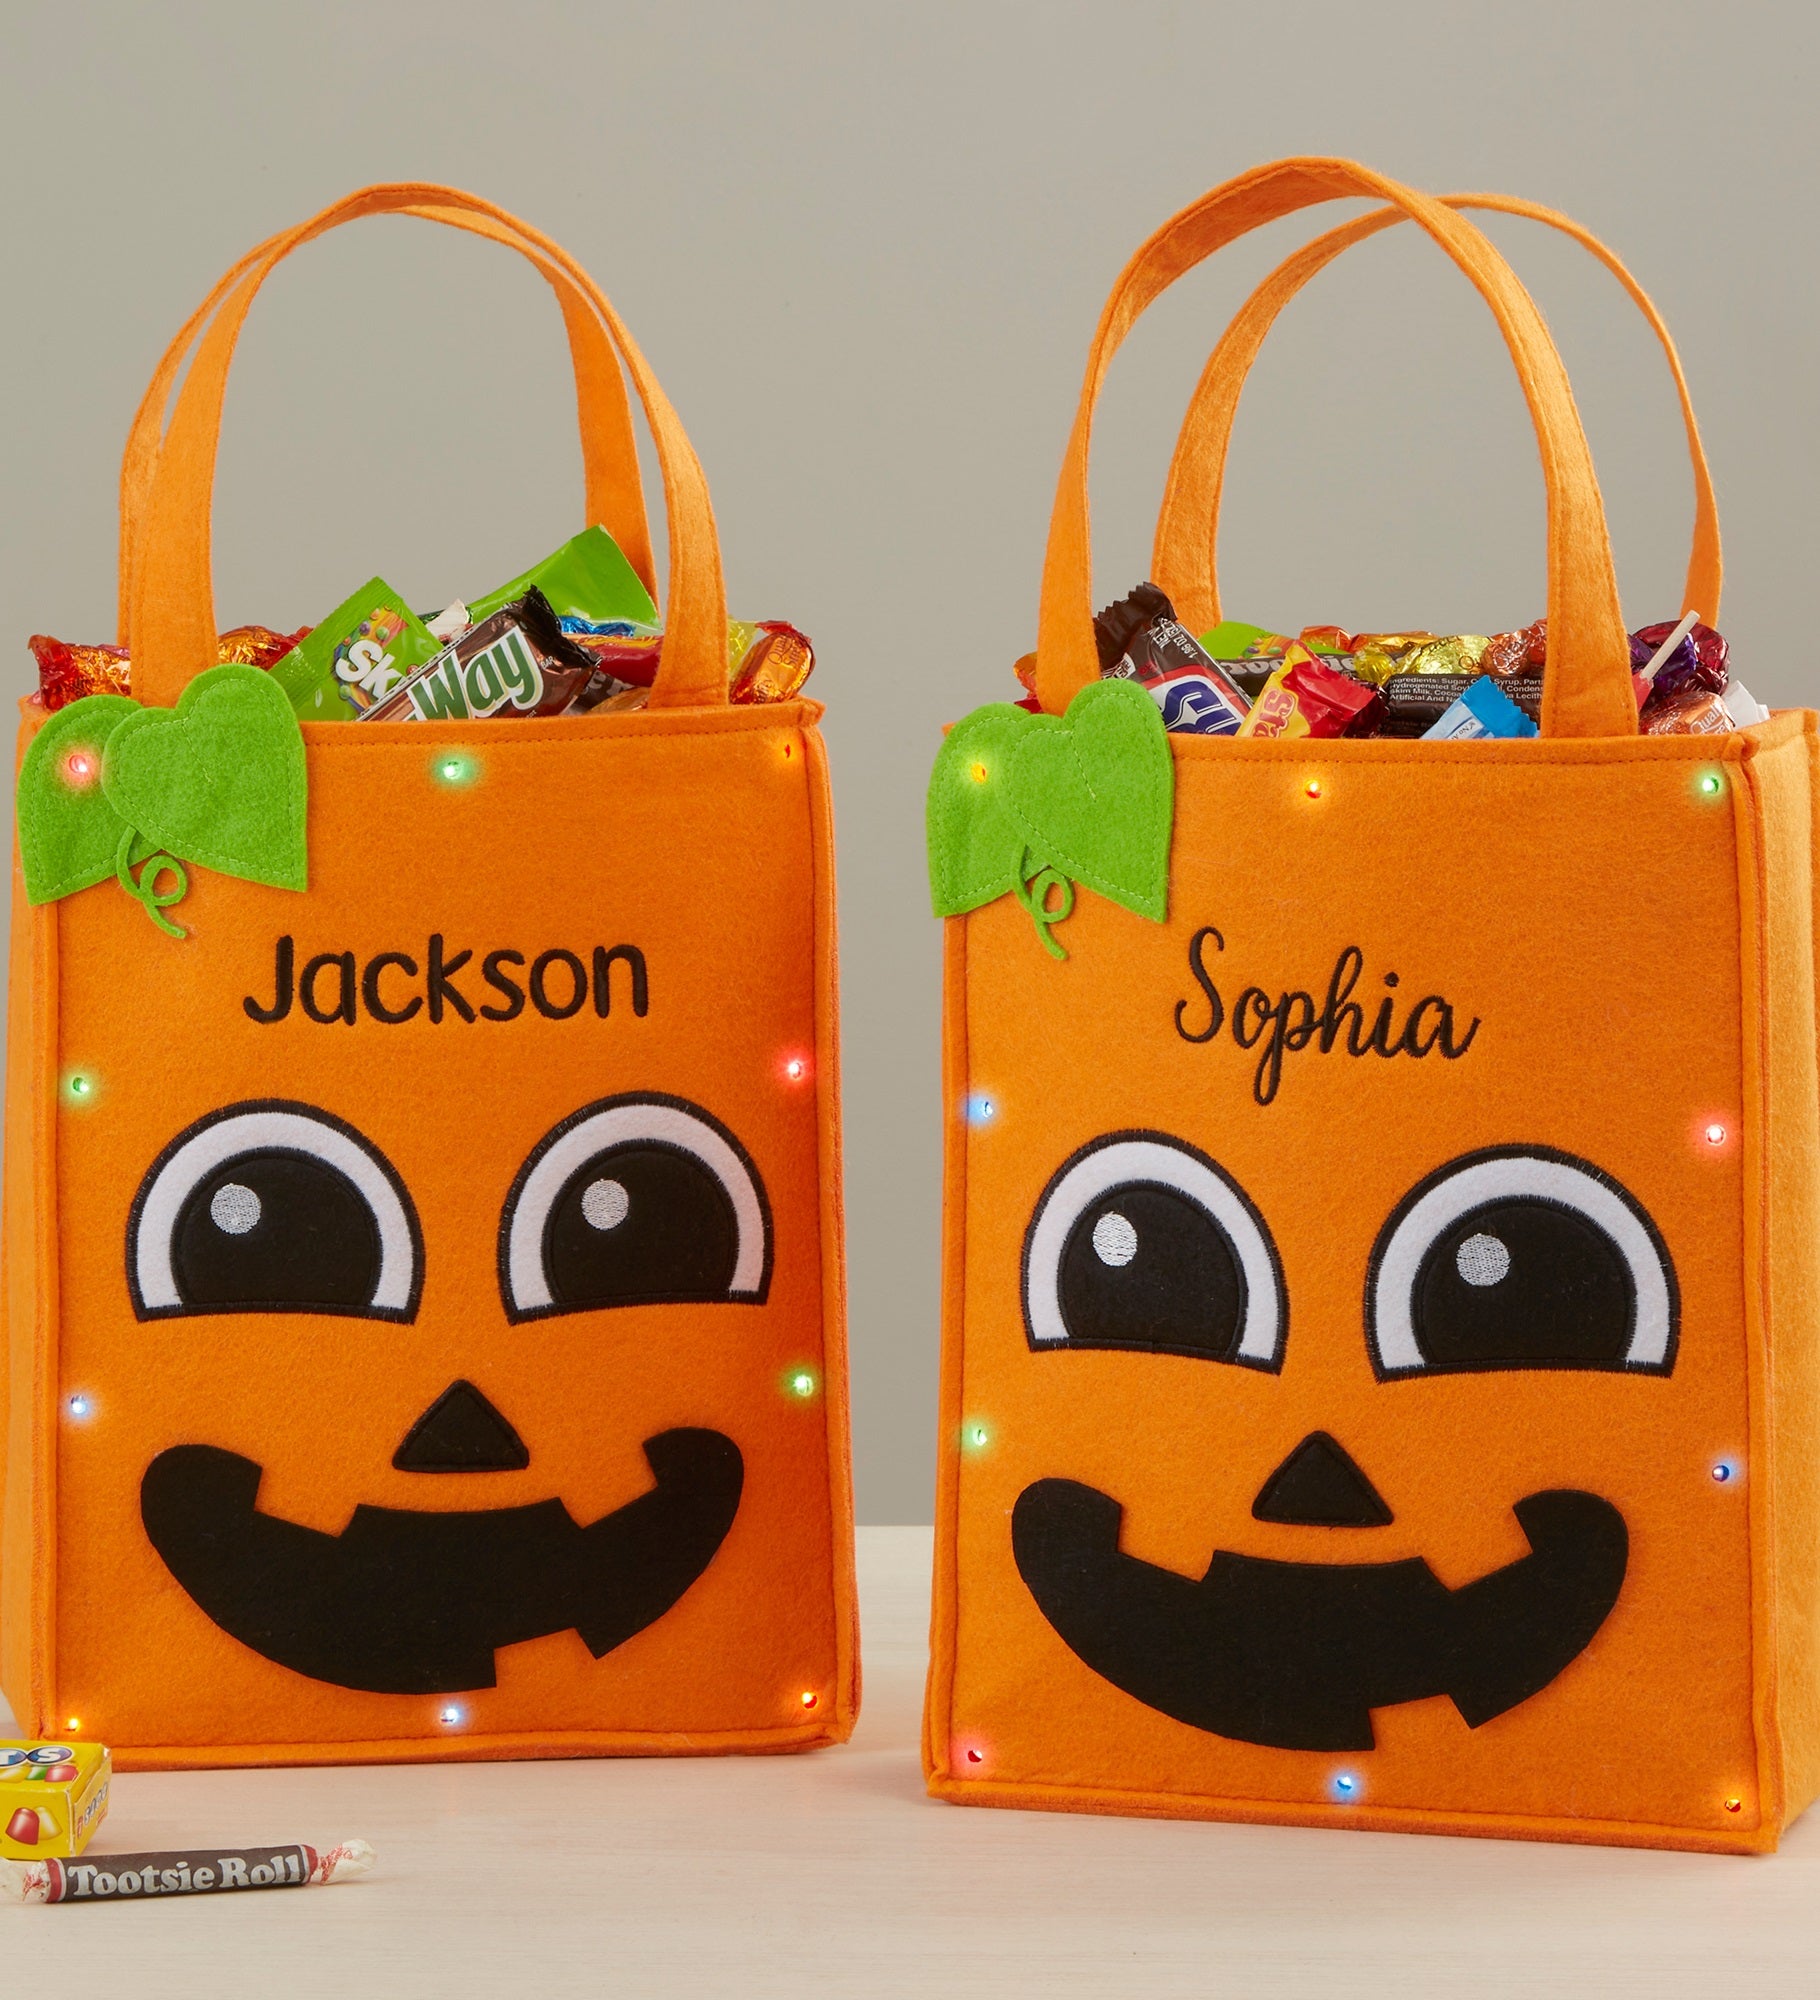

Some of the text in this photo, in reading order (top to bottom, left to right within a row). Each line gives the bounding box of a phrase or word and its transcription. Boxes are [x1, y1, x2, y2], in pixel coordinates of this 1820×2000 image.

[243, 933, 649, 1026] Jackson
[1175, 926, 1482, 1106] Sophia
[67, 1860, 215, 1896] Tootsie
[217, 1853, 302, 1889] Roll
